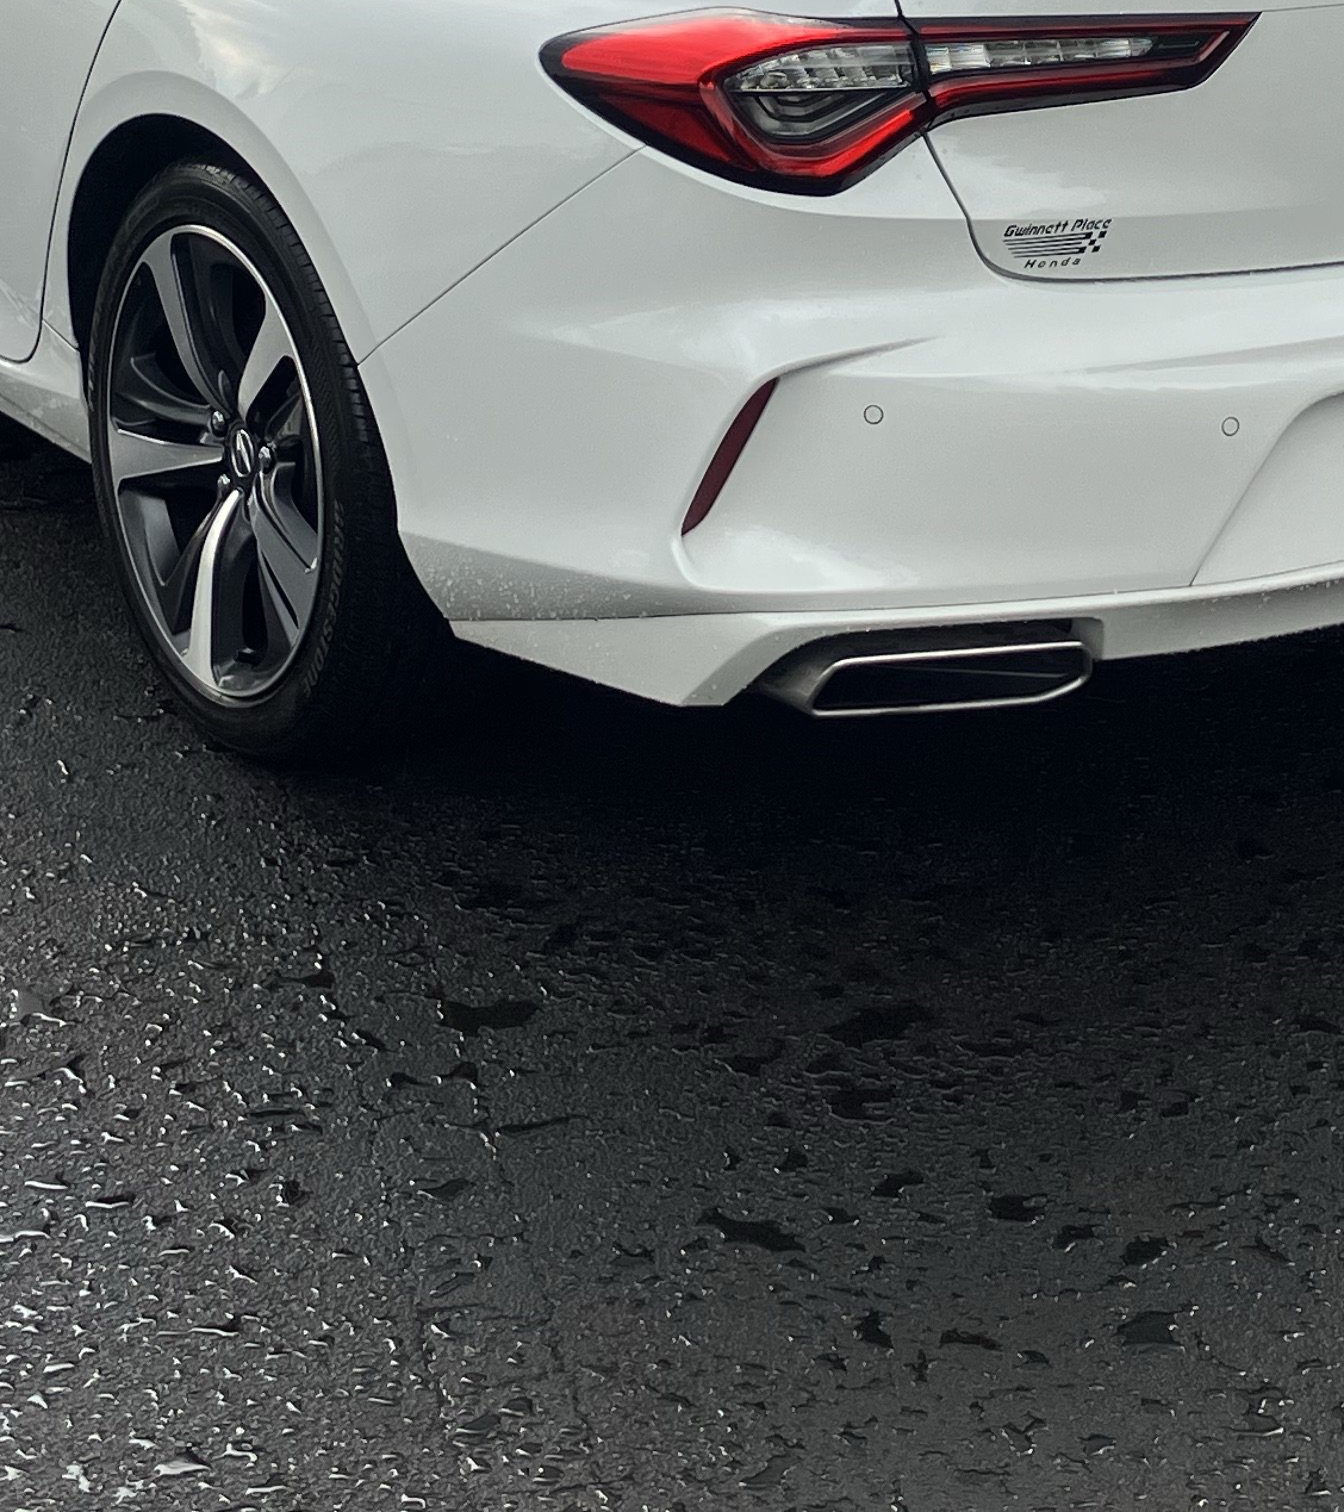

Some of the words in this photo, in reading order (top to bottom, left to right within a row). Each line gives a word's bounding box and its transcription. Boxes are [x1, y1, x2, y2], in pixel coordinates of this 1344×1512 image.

[1003, 220, 1069, 237] Gwinnett
[1071, 218, 1112, 231] Place
[1024, 257, 1081, 268] Honda
